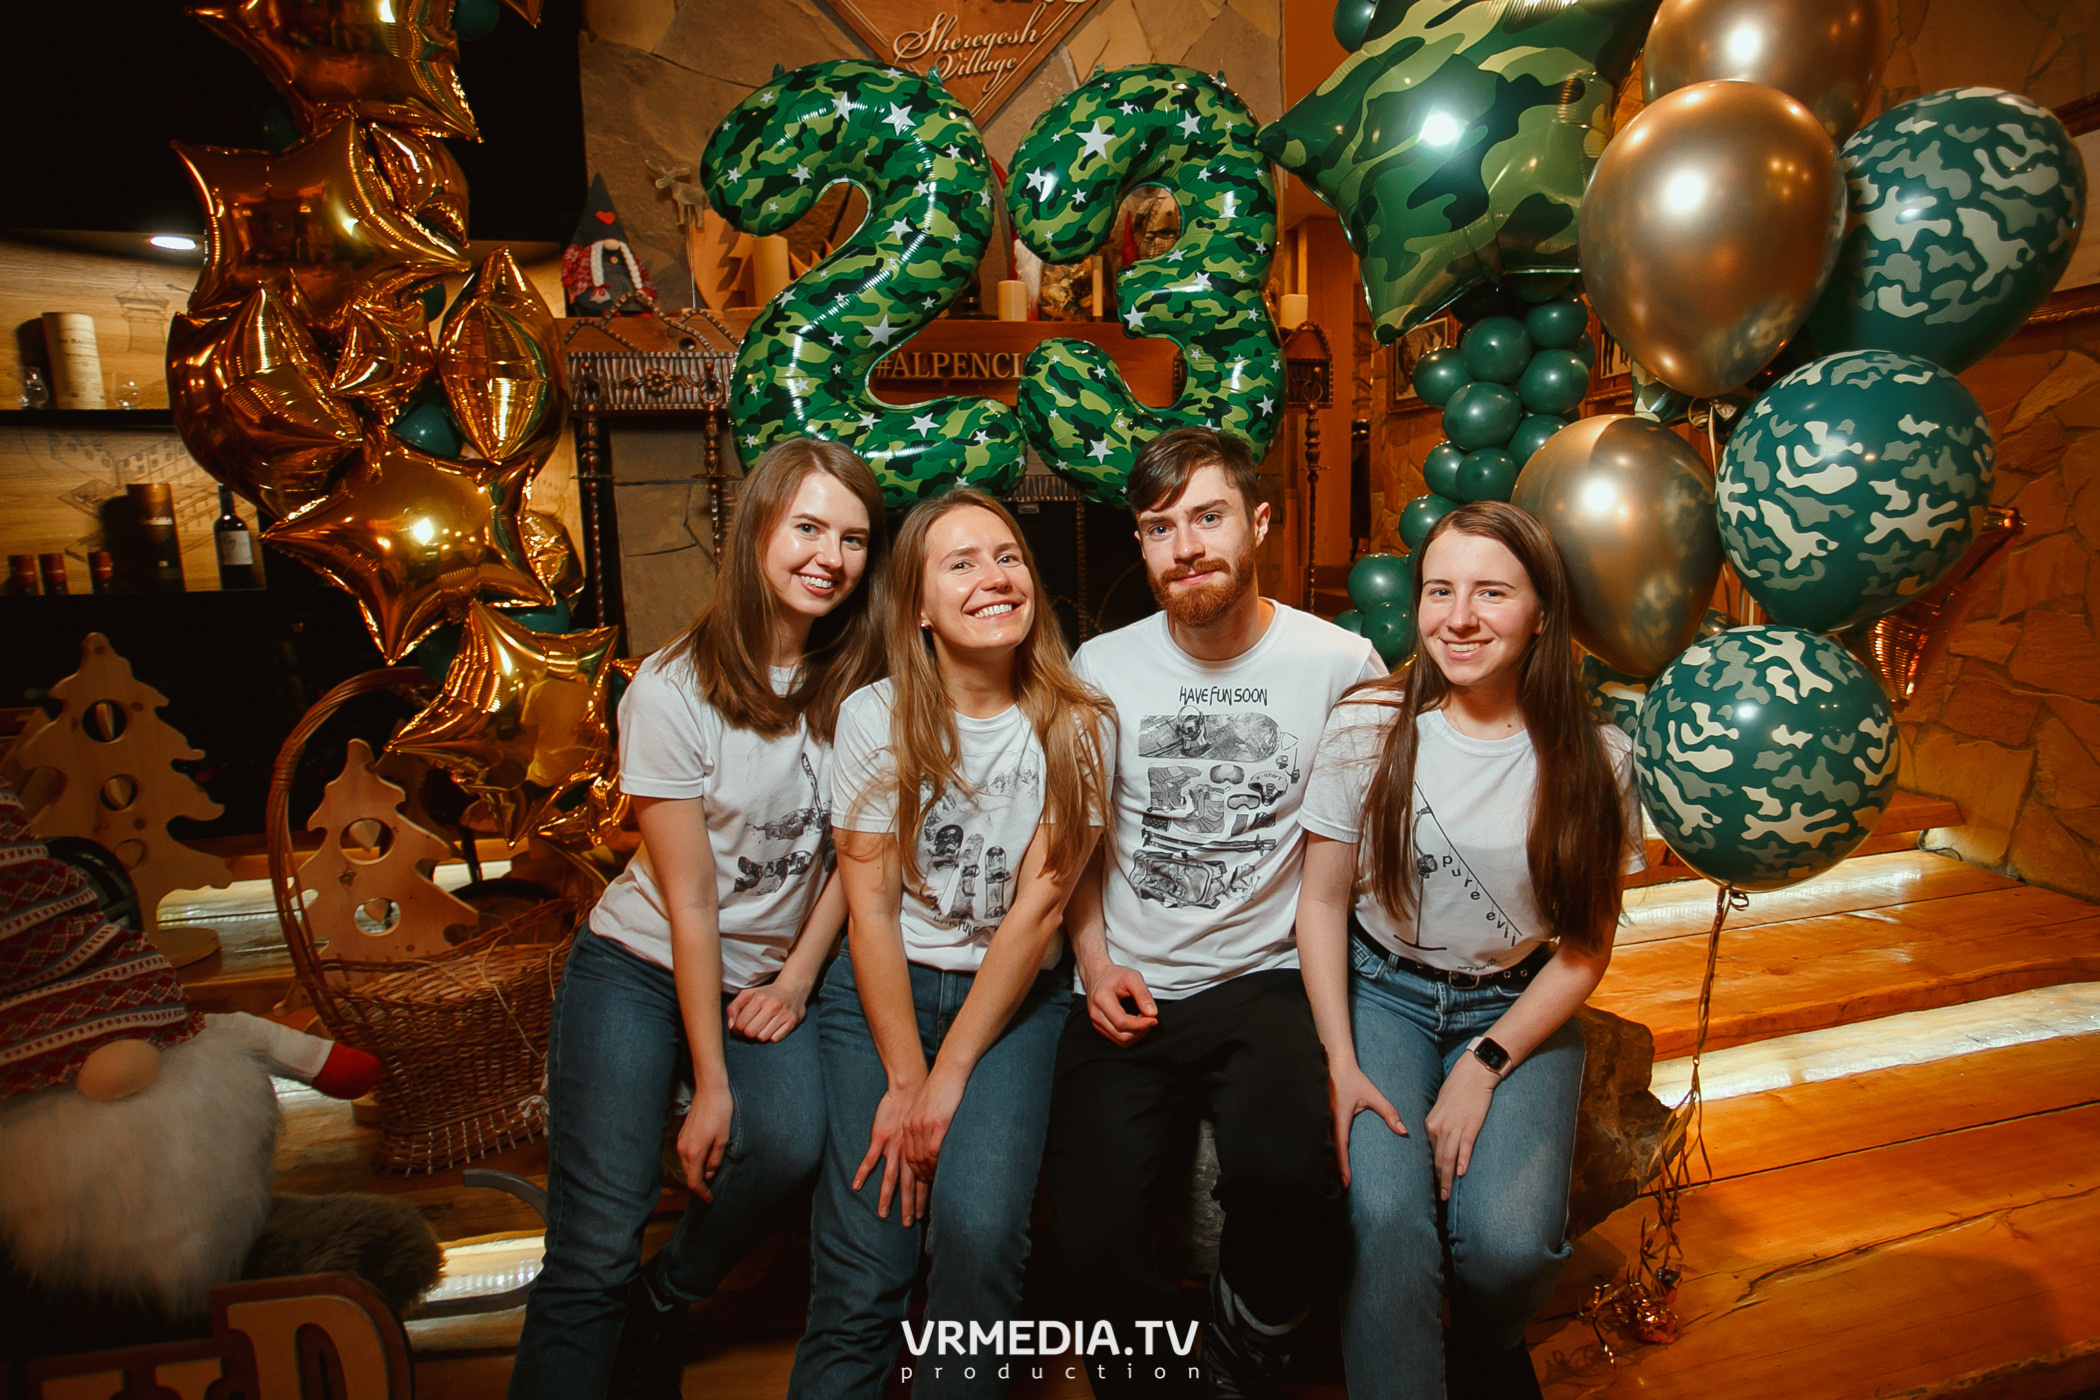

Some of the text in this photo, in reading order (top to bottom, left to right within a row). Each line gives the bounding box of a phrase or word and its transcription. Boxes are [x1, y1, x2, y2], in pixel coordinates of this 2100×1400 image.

[893, 2, 1046, 63] Sheregesh
[936, 47, 1018, 92] Village
[1179, 686, 1268, 706] HAVE FUN SOON
[1442, 855, 1517, 947] pure evil
